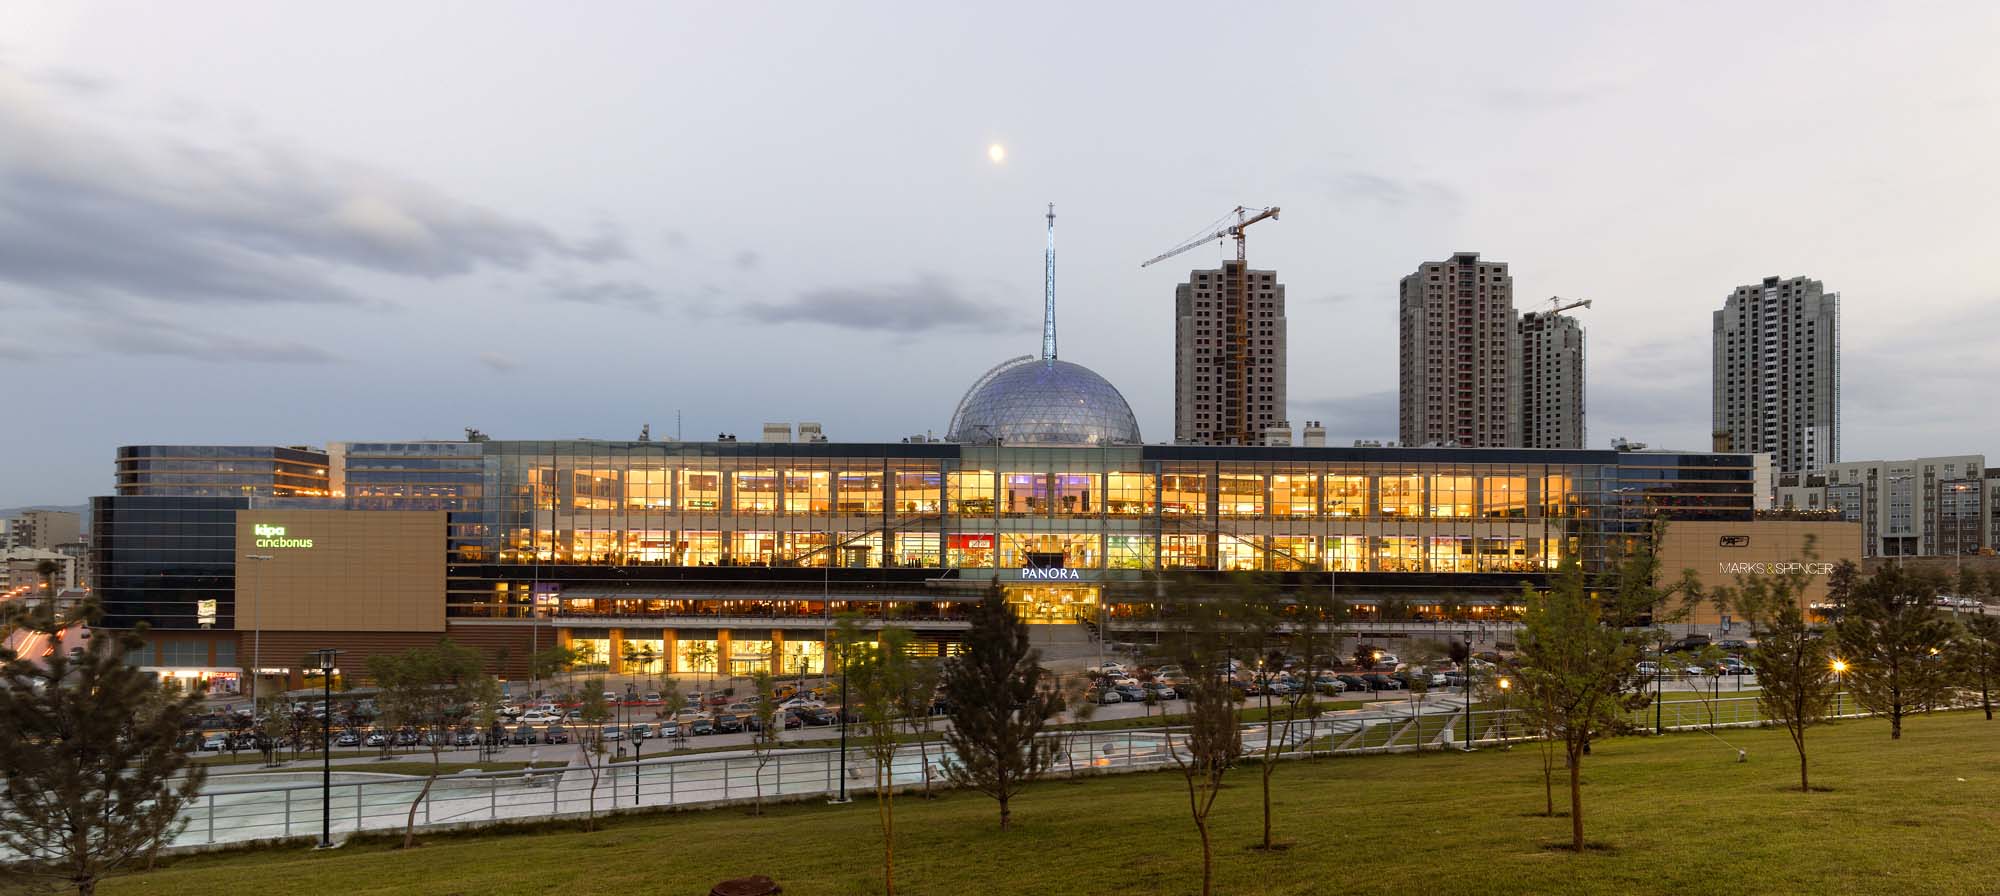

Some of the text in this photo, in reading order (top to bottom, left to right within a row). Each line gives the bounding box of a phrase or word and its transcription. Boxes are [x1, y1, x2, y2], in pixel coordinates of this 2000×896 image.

[255, 524, 285, 538] kipa
[256, 537, 313, 548] cinebonus
[1022, 568, 1080, 579] PANORA
[1719, 562, 1834, 575] MARKS & SPENCER
